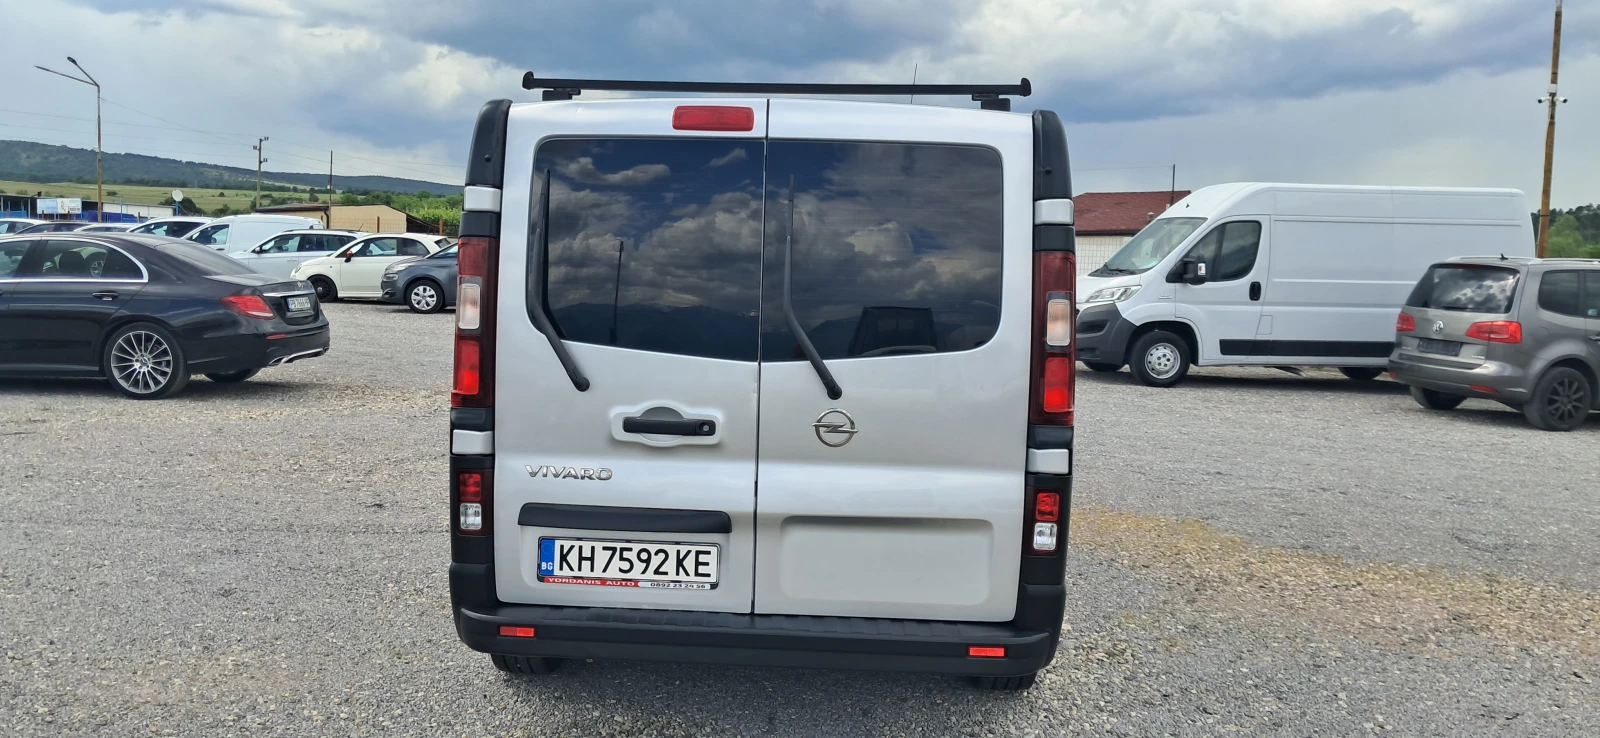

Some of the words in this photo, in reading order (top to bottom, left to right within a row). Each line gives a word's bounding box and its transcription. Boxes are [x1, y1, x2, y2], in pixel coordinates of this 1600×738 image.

[525, 465, 613, 480] VIVARO
[541, 561, 553, 571] BG
[548, 577, 601, 585] YORDANIS
